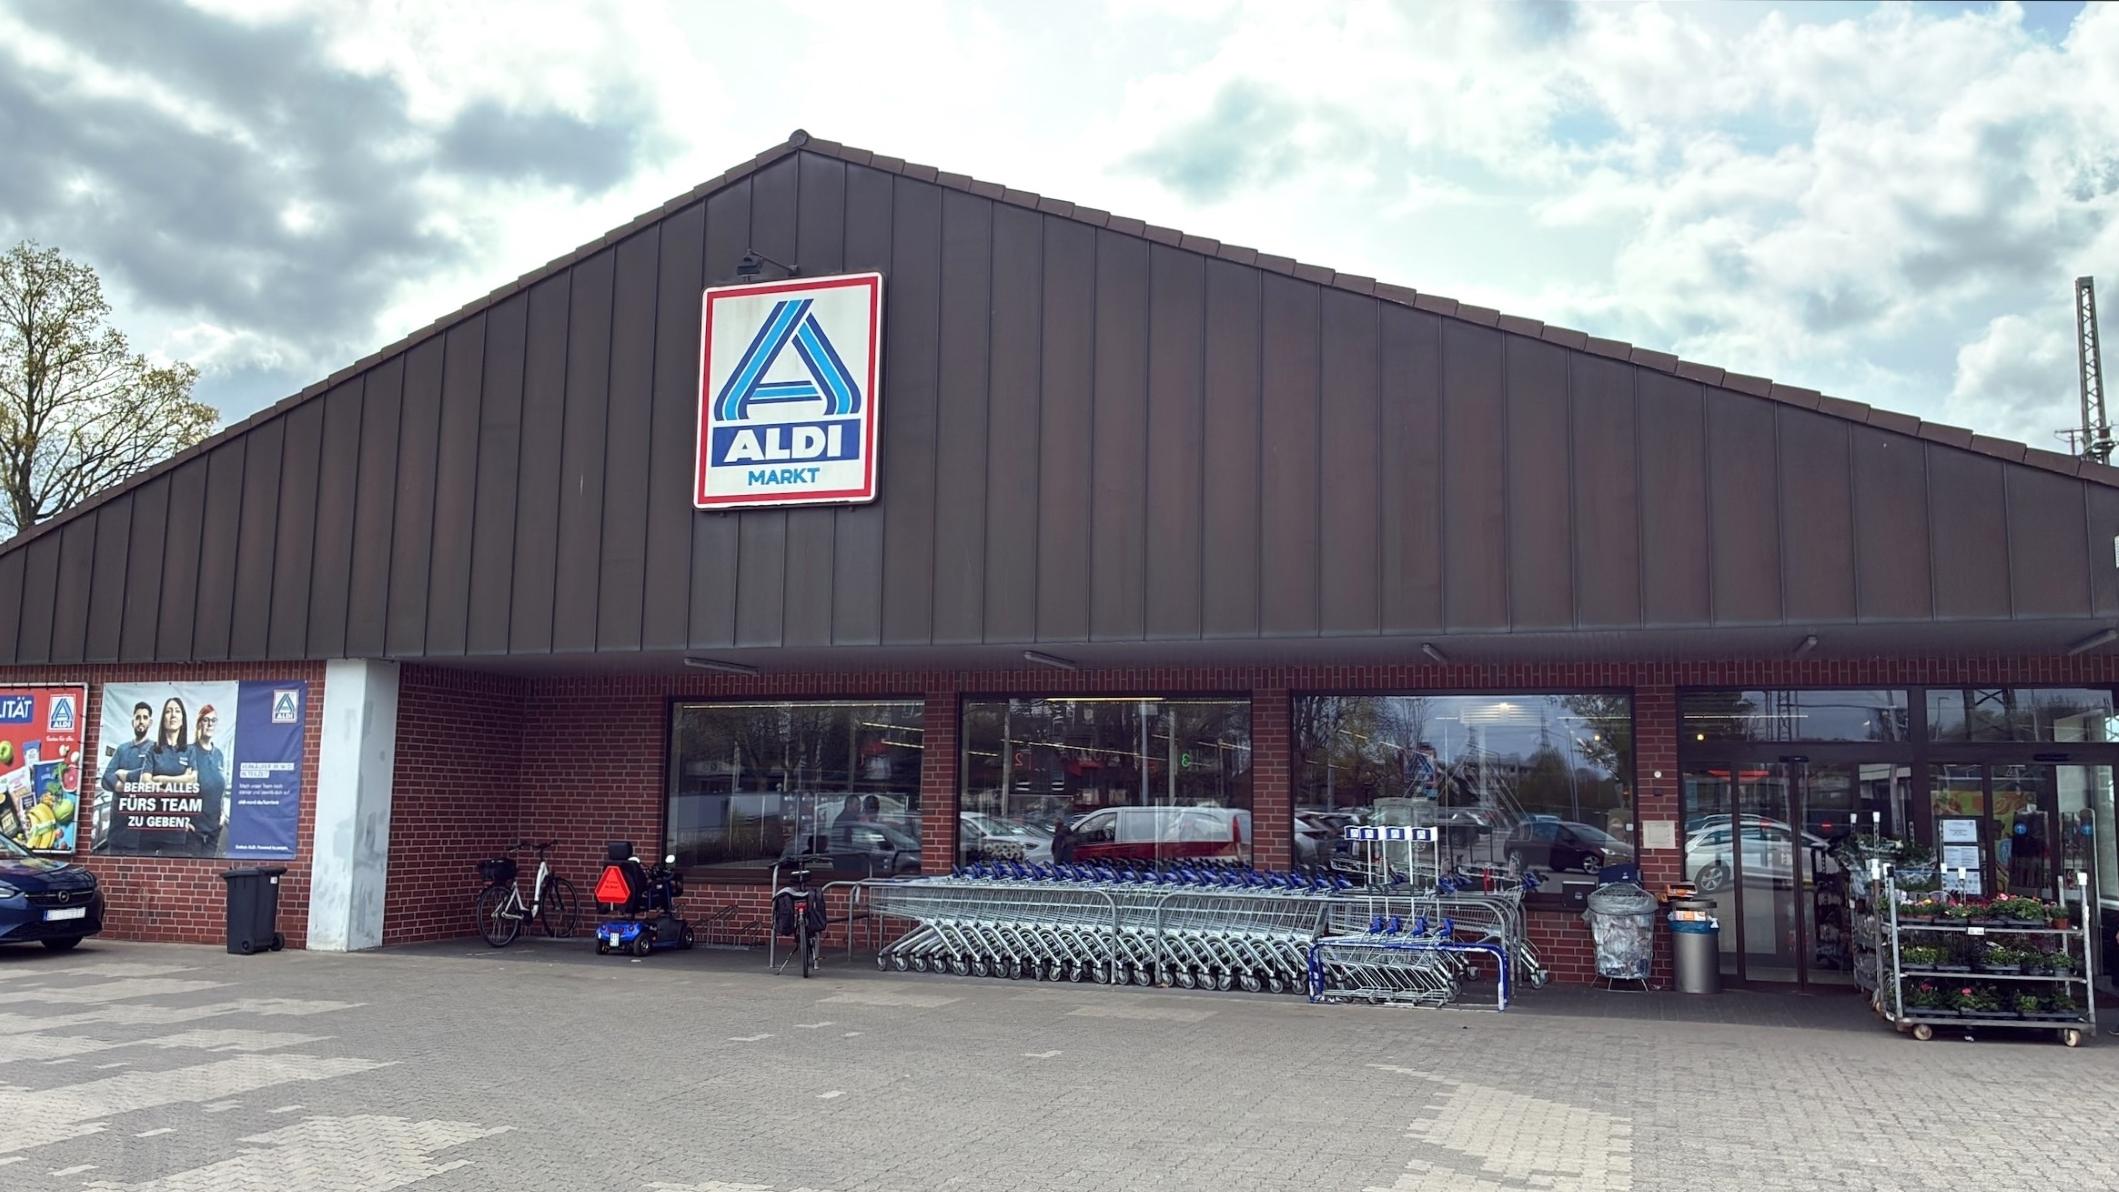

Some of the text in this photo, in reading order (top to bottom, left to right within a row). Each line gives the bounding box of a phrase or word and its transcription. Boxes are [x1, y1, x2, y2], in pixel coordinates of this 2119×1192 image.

[723, 424, 842, 463] ALDI
[748, 467, 821, 486] MARKT
[0, 697, 32, 718] ITÄT
[124, 782, 200, 793] BEREIT ALLES
[119, 794, 202, 812] FÜRS TEAM
[128, 816, 190, 828] ZU GEBEN?
